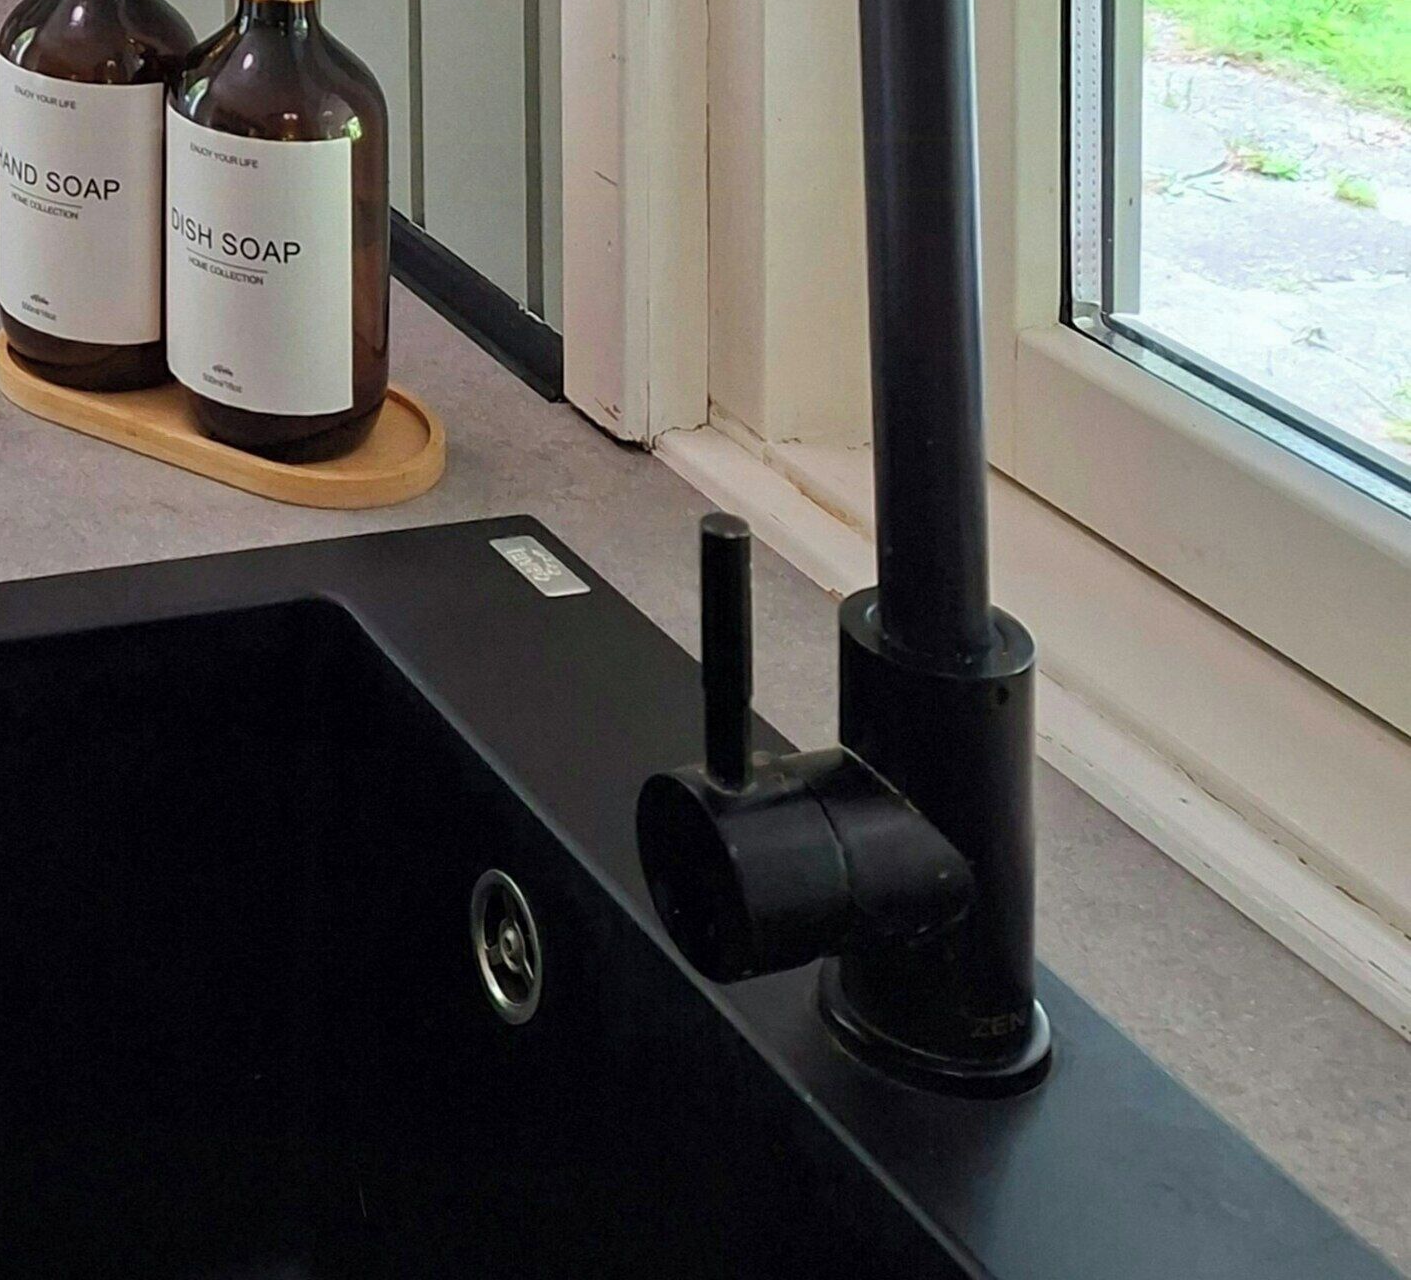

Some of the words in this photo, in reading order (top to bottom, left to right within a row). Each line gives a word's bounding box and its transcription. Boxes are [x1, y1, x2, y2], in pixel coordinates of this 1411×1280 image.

[14, 84, 35, 99] ENJOY
[36, 93, 58, 107] YOUR
[59, 98, 77, 110] LIFE
[190, 142, 213, 157] ENJOY
[214, 151, 239, 165] YOUR
[239, 157, 259, 169] LIFE
[46, 172, 121, 201] SOAP
[11, 191, 29, 207] HOME
[30, 199, 79, 220] COLLECTION
[171, 206, 213, 249] DISH
[221, 232, 301, 264] SOAP
[188, 255, 209, 271] HOME
[210, 264, 264, 286] COLLECTION
